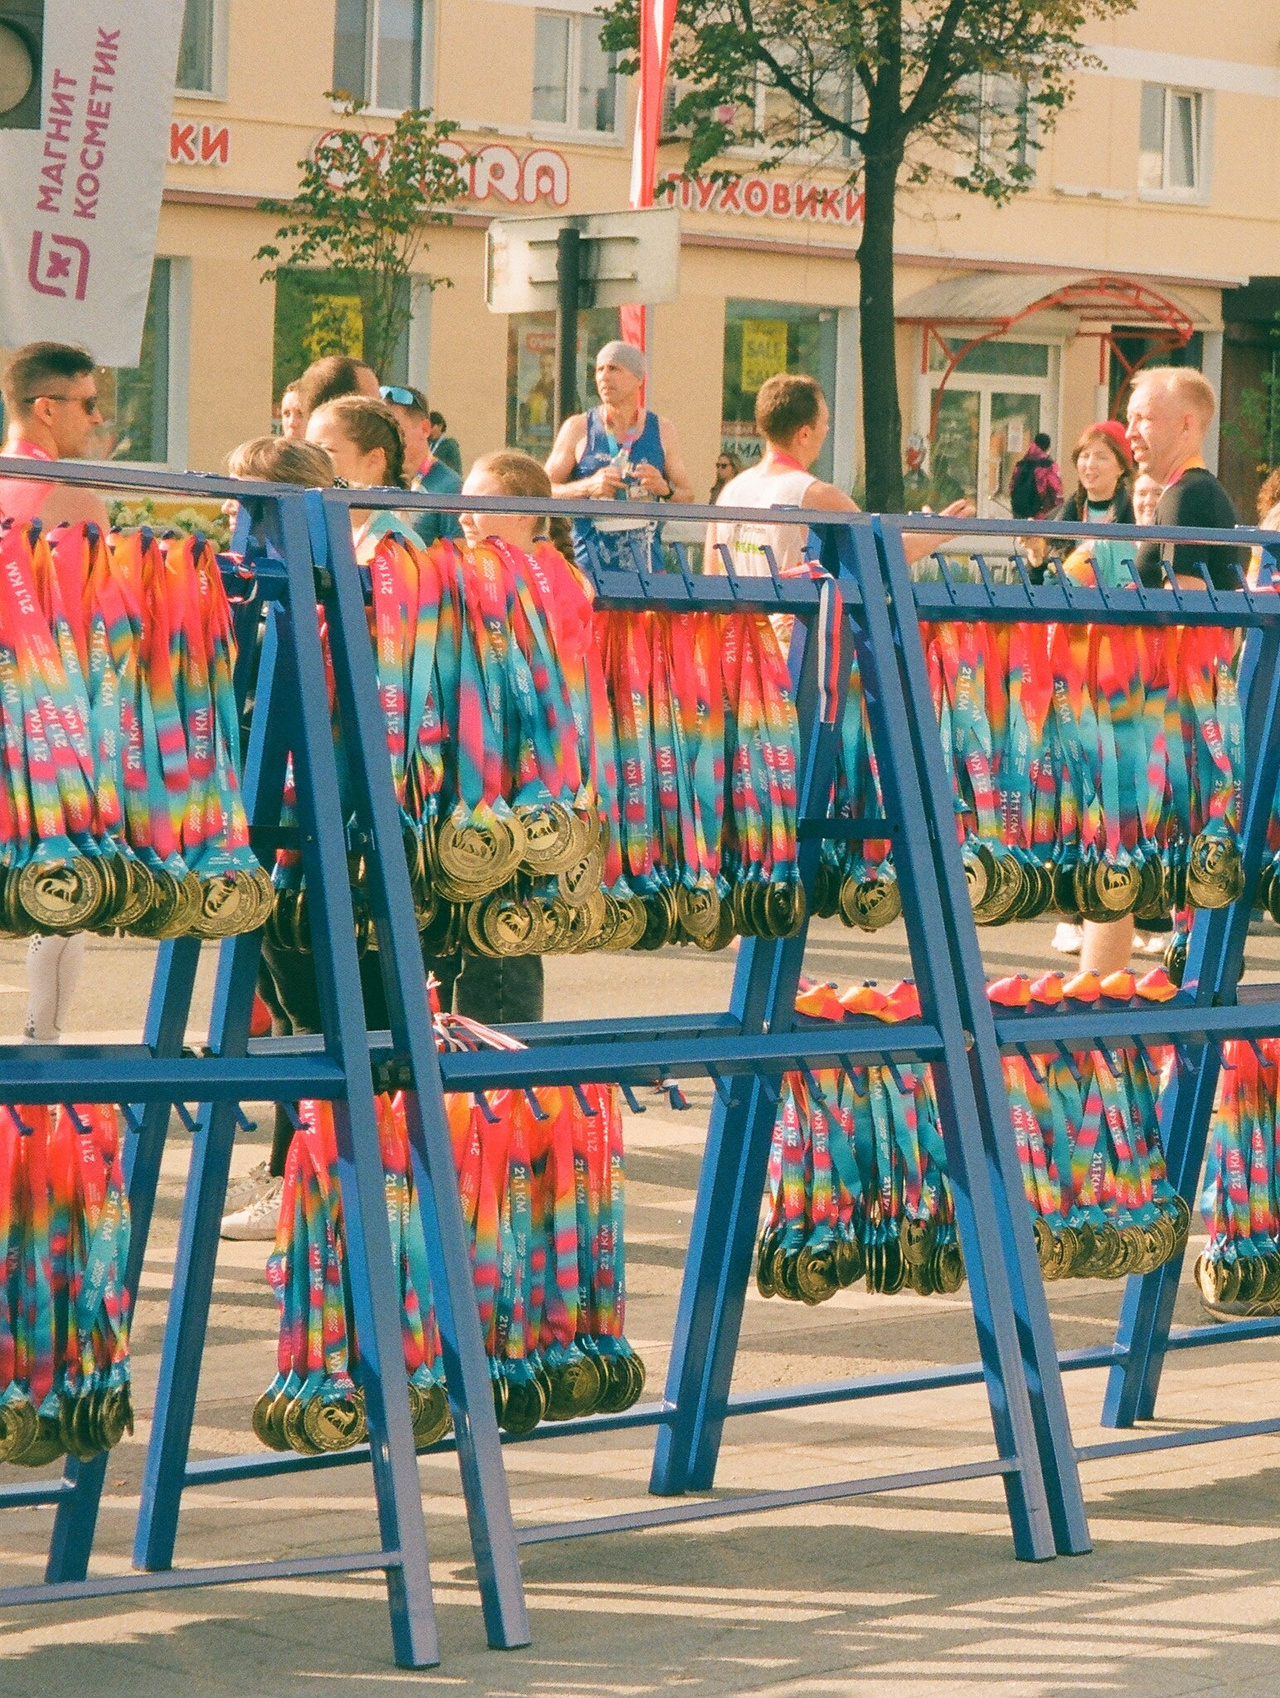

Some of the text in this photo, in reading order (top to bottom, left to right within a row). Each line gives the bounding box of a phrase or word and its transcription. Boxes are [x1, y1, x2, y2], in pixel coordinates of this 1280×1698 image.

[36, 68, 78, 213] МАГНИТ
[74, 26, 121, 220] КОСМЕТИК
[667, 172, 866, 222] ПУХОВИКИ
